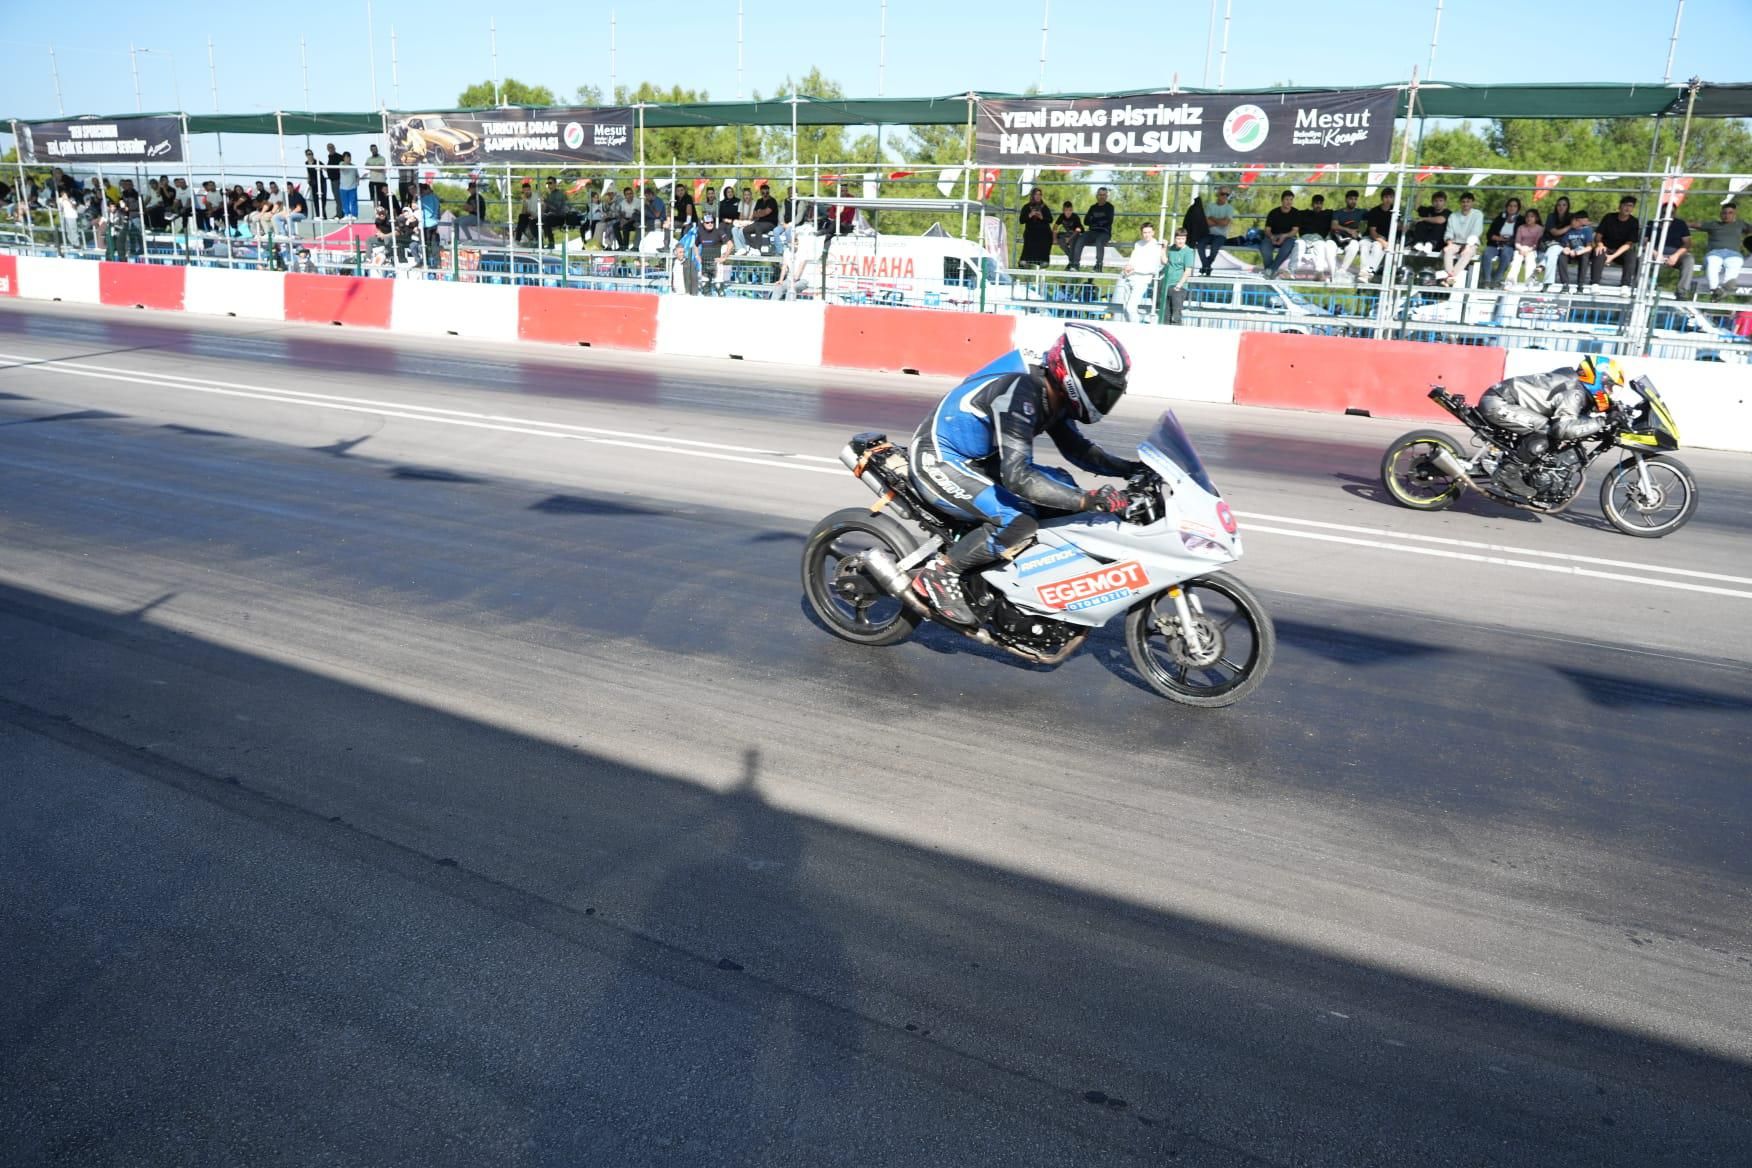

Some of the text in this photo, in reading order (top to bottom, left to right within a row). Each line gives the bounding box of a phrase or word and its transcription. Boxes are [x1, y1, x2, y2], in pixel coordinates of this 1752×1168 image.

[528, 120, 558, 134] DRAG
[1000, 103, 1204, 128] YENİ DRAG PİSTİMİZ
[1295, 108, 1371, 128] Mesut
[594, 123, 626, 136] Mesut
[1000, 131, 1202, 154] HAYIRLI OLSUN
[839, 254, 915, 278] YAMAHA
[1040, 563, 1139, 605] EGEMOT
